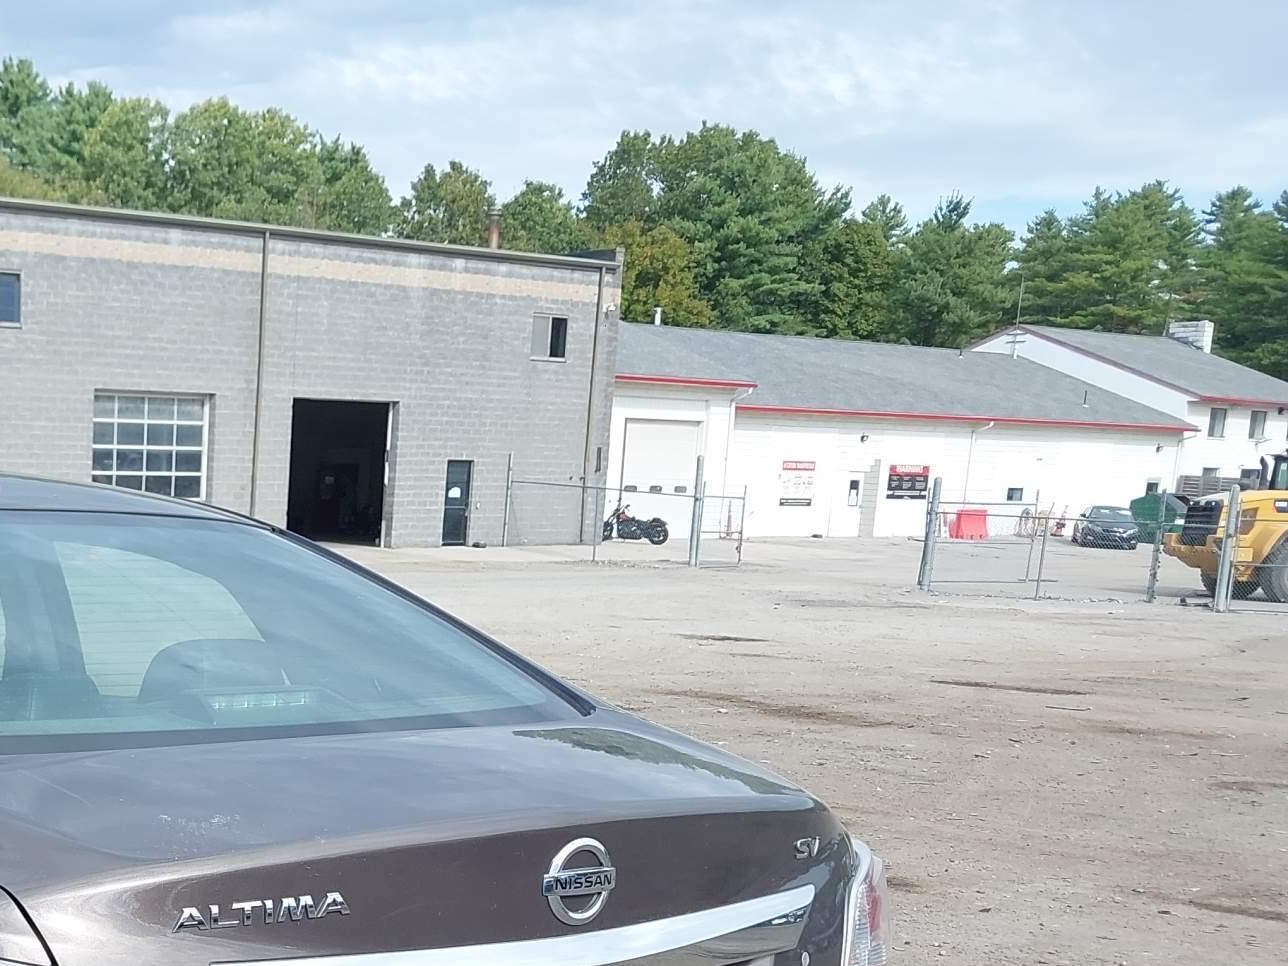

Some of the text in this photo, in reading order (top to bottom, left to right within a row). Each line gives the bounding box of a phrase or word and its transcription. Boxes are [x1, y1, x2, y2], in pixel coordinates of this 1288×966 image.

[795, 836, 819, 859] SV
[554, 873, 612, 891] NISSAN
[171, 891, 351, 933] ALTIMA
